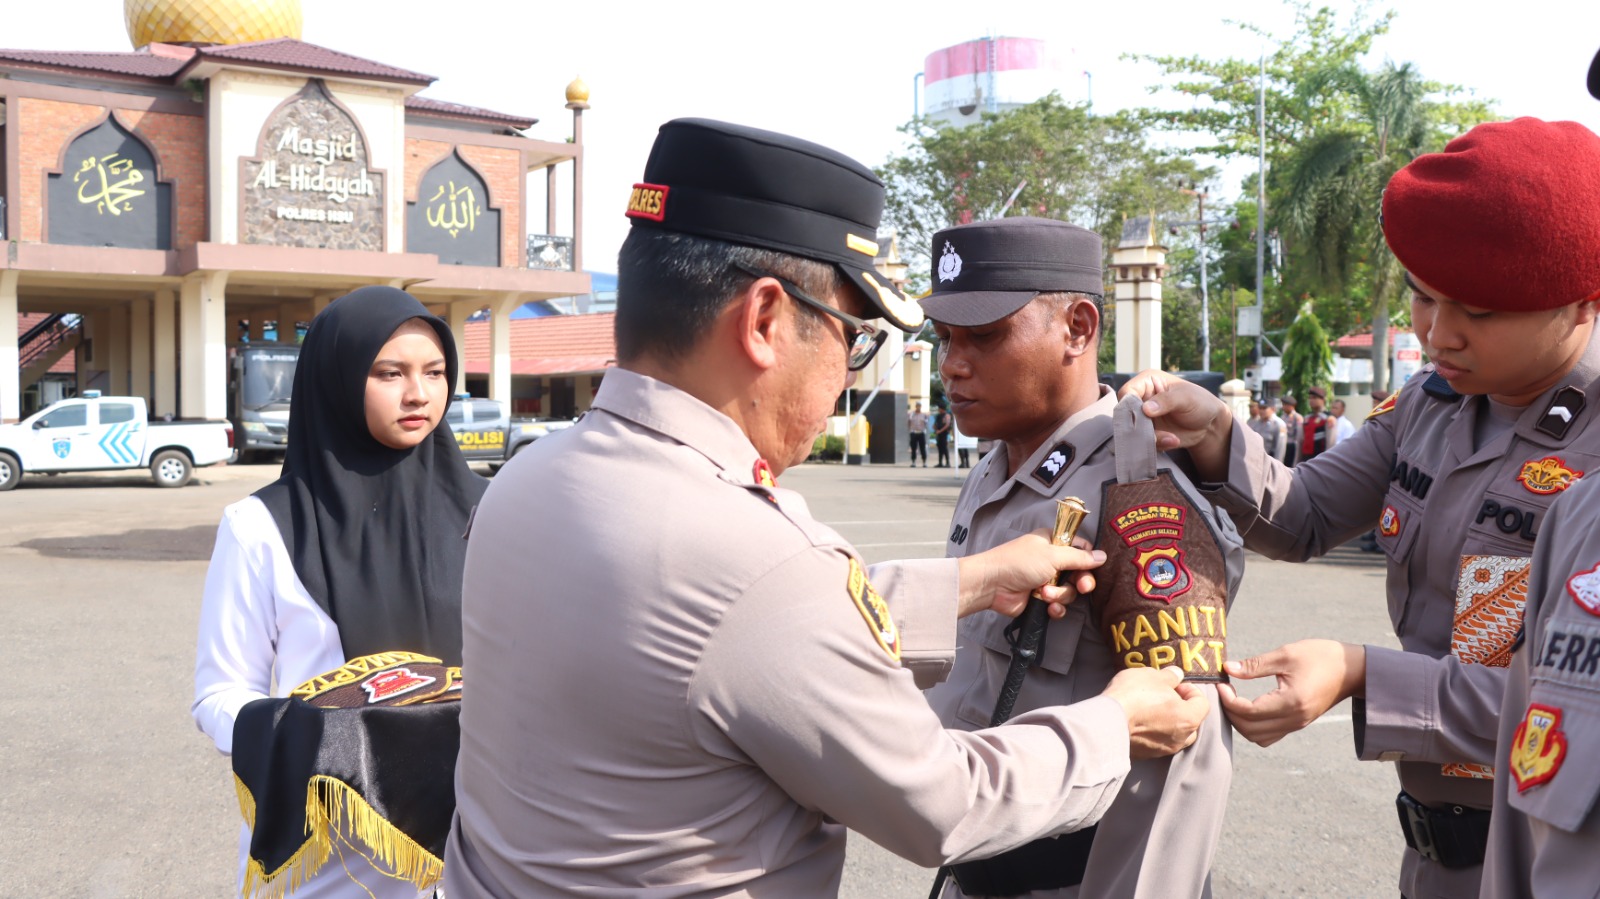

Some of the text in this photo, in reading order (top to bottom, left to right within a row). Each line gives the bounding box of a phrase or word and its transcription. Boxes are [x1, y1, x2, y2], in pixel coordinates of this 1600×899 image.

[277, 127, 356, 165] Masjid
[277, 207, 326, 222] POLRES
[454, 431, 504, 445] POLISI
[1117, 506, 1179, 525] POLRES
[1124, 640, 1224, 673] SPKT
[292, 652, 436, 696] AMAPTA
